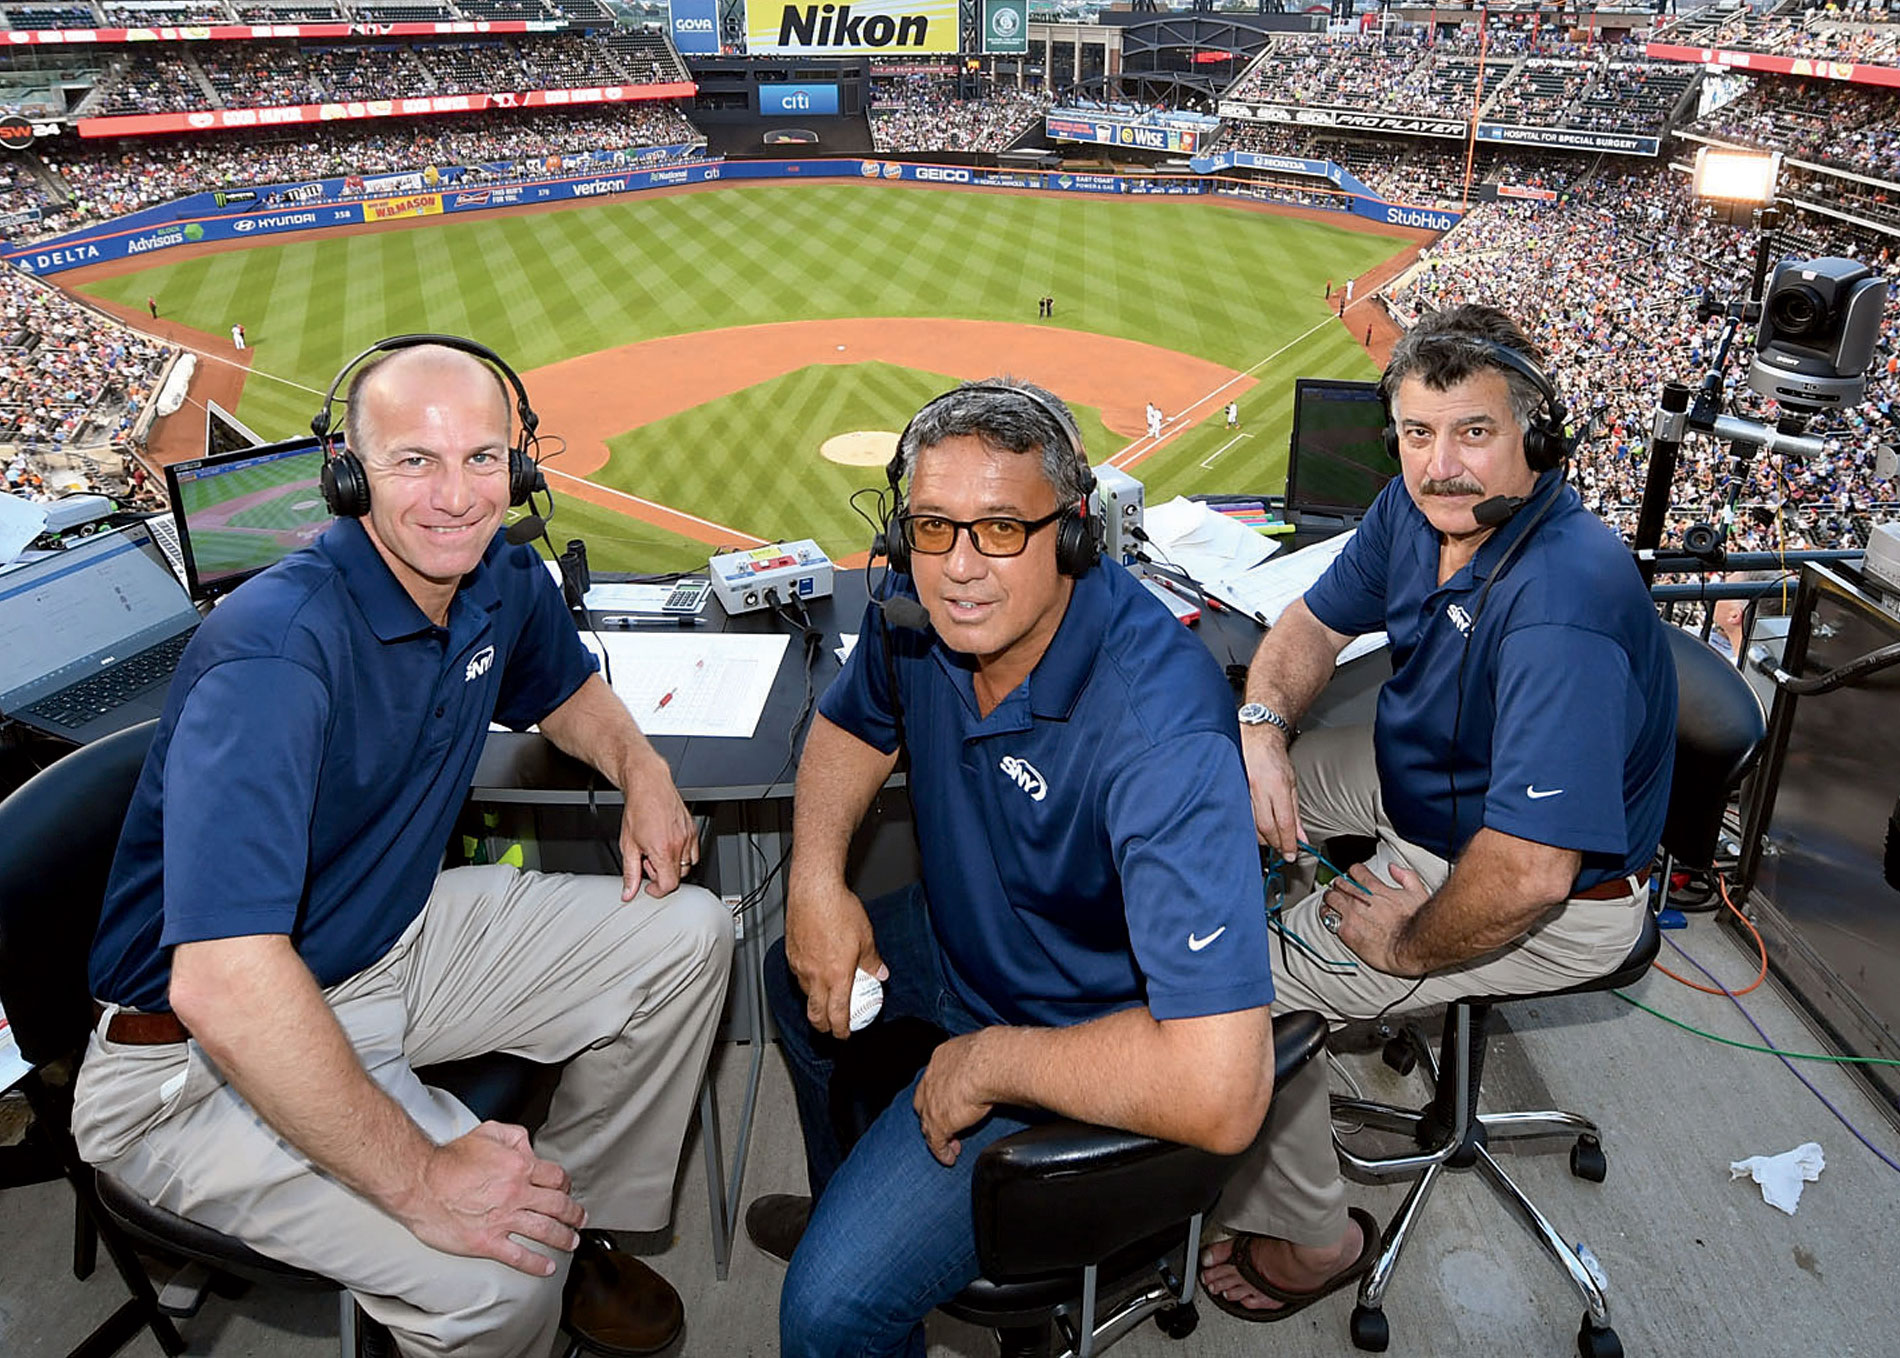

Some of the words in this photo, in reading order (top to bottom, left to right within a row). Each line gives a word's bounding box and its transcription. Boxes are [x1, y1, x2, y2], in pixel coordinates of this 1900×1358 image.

[676, 19, 713, 29] GOYA
[777, 4, 928, 47] Nikon
[782, 94, 809, 110] citi
[1337, 115, 1380, 126] PRO
[1380, 119, 1464, 134] PLAYER
[1134, 129, 1164, 147] WISE
[1504, 132, 1539, 141] HOSPITAL
[1541, 134, 1556, 142] FOR
[1559, 136, 1594, 145] SPECIAL
[1596, 138, 1637, 149] SURGERY
[705, 167, 720, 179] citi
[1264, 159, 1306, 170] HONDA
[915, 167, 969, 182] GEICO
[573, 180, 625, 196] verizon
[258, 213, 316, 228] HYUNDAI
[1387, 208, 1451, 230] StubHub
[128, 232, 183, 254] Advisors
[37, 245, 100, 268] DELTA
[1000, 756, 1042, 795] SNY
